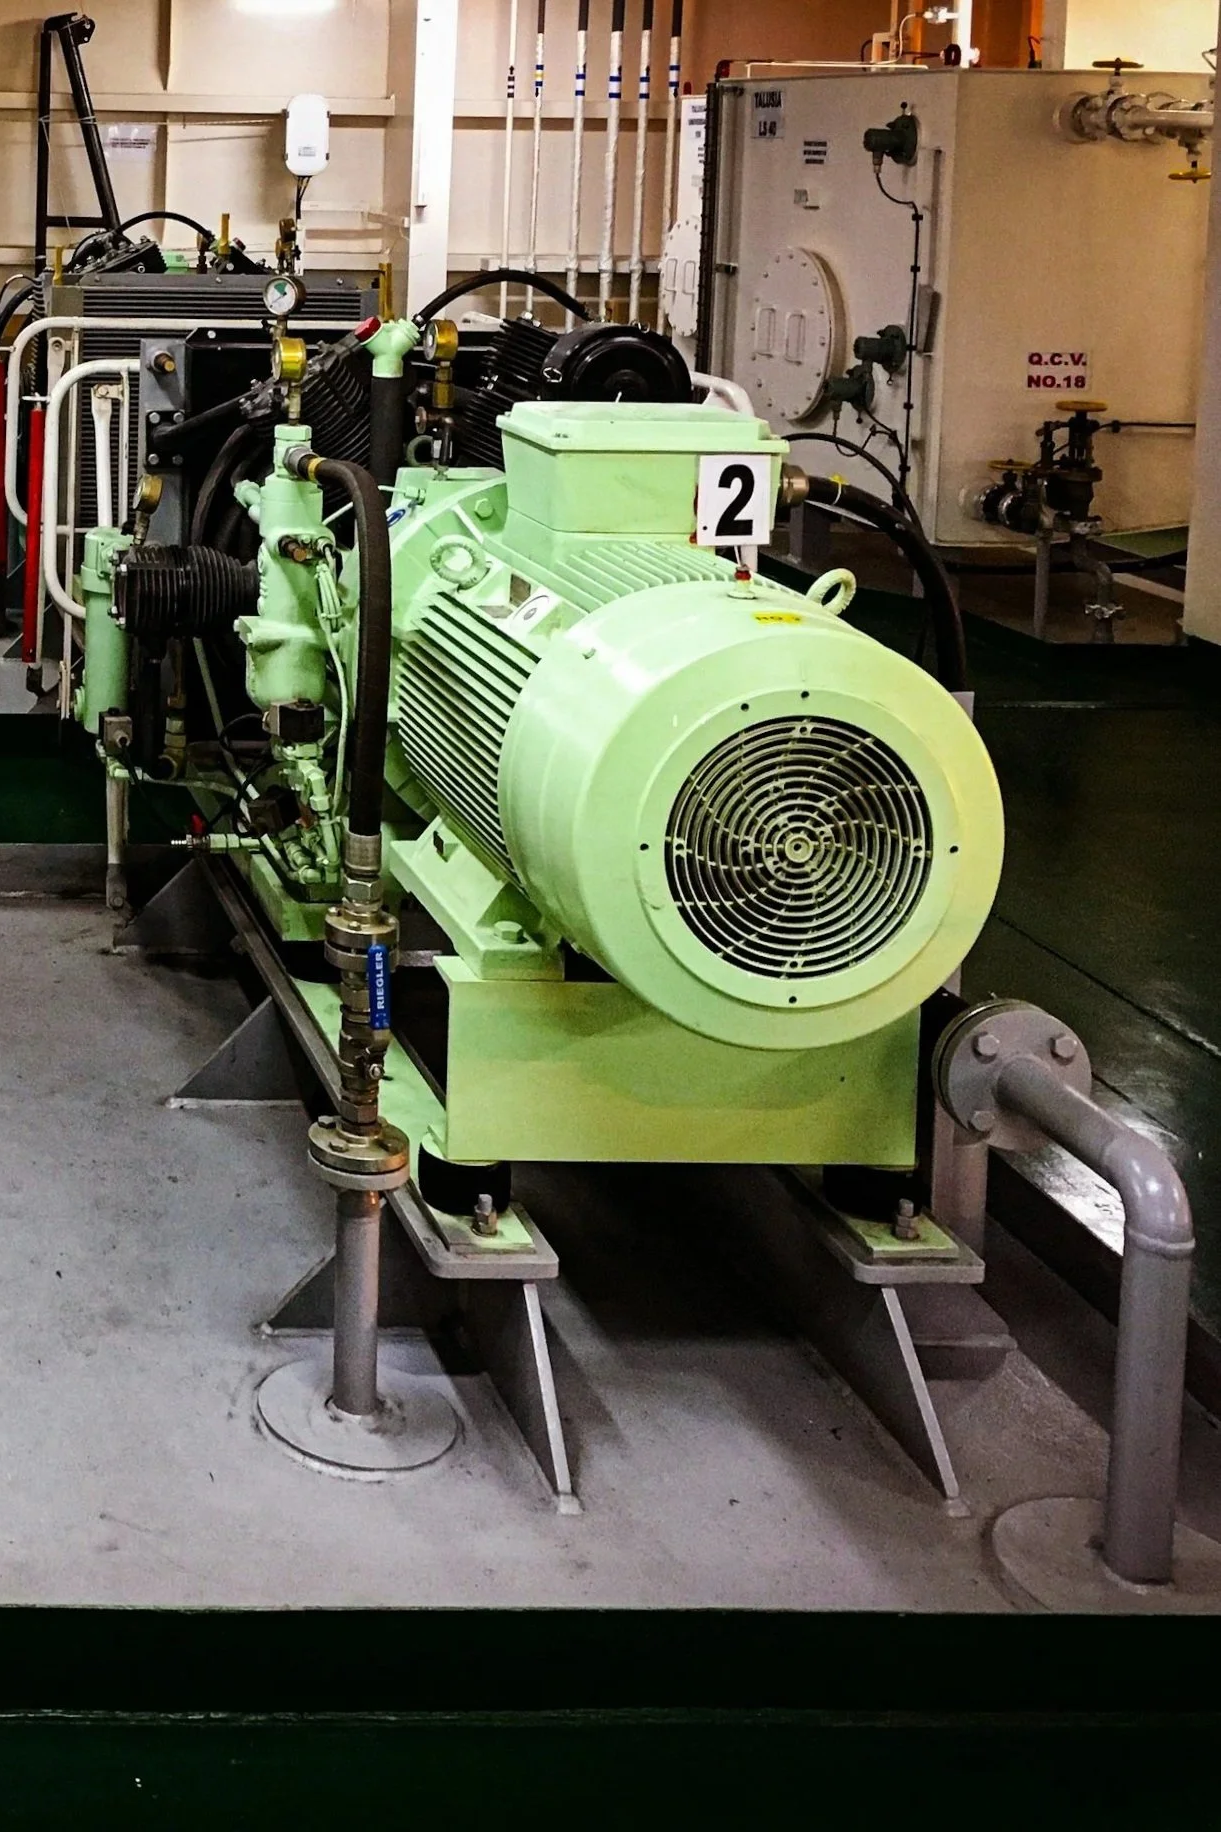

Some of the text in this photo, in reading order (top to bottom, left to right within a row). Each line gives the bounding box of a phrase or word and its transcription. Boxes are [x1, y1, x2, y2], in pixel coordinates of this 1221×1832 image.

[1028, 352, 1087, 366] Q.C.V.
[1027, 374, 1086, 388] NO.18
[715, 463, 755, 536] 2
[374, 951, 385, 1010] RIEGLER
